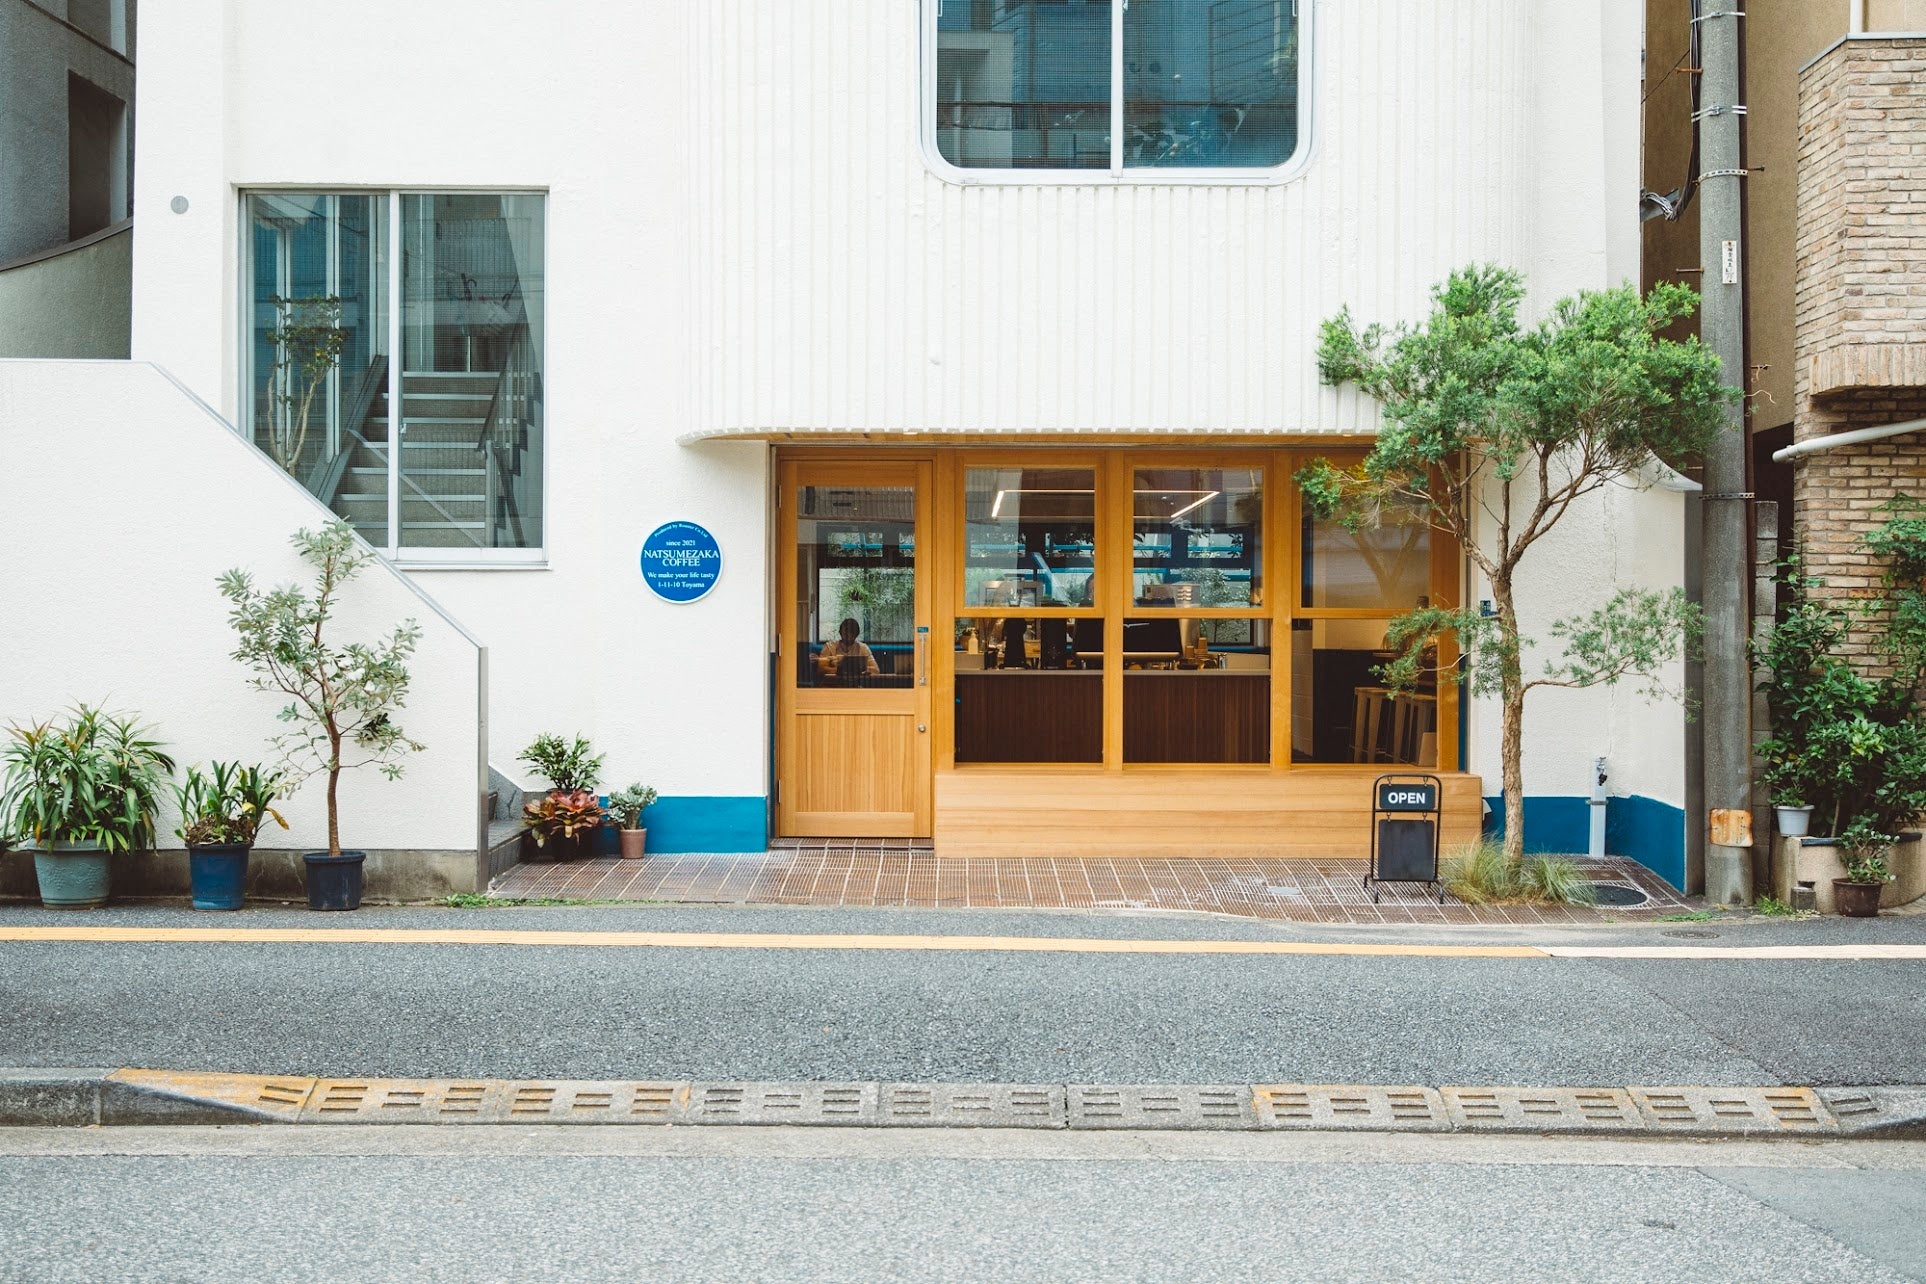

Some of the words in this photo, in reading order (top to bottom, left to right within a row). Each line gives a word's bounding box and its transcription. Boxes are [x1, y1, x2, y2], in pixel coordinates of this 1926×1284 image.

[644, 549, 719, 558] NATSUMEZAKA
[662, 558, 700, 567] COFFEE
[1388, 792, 1426, 804] OPEN
